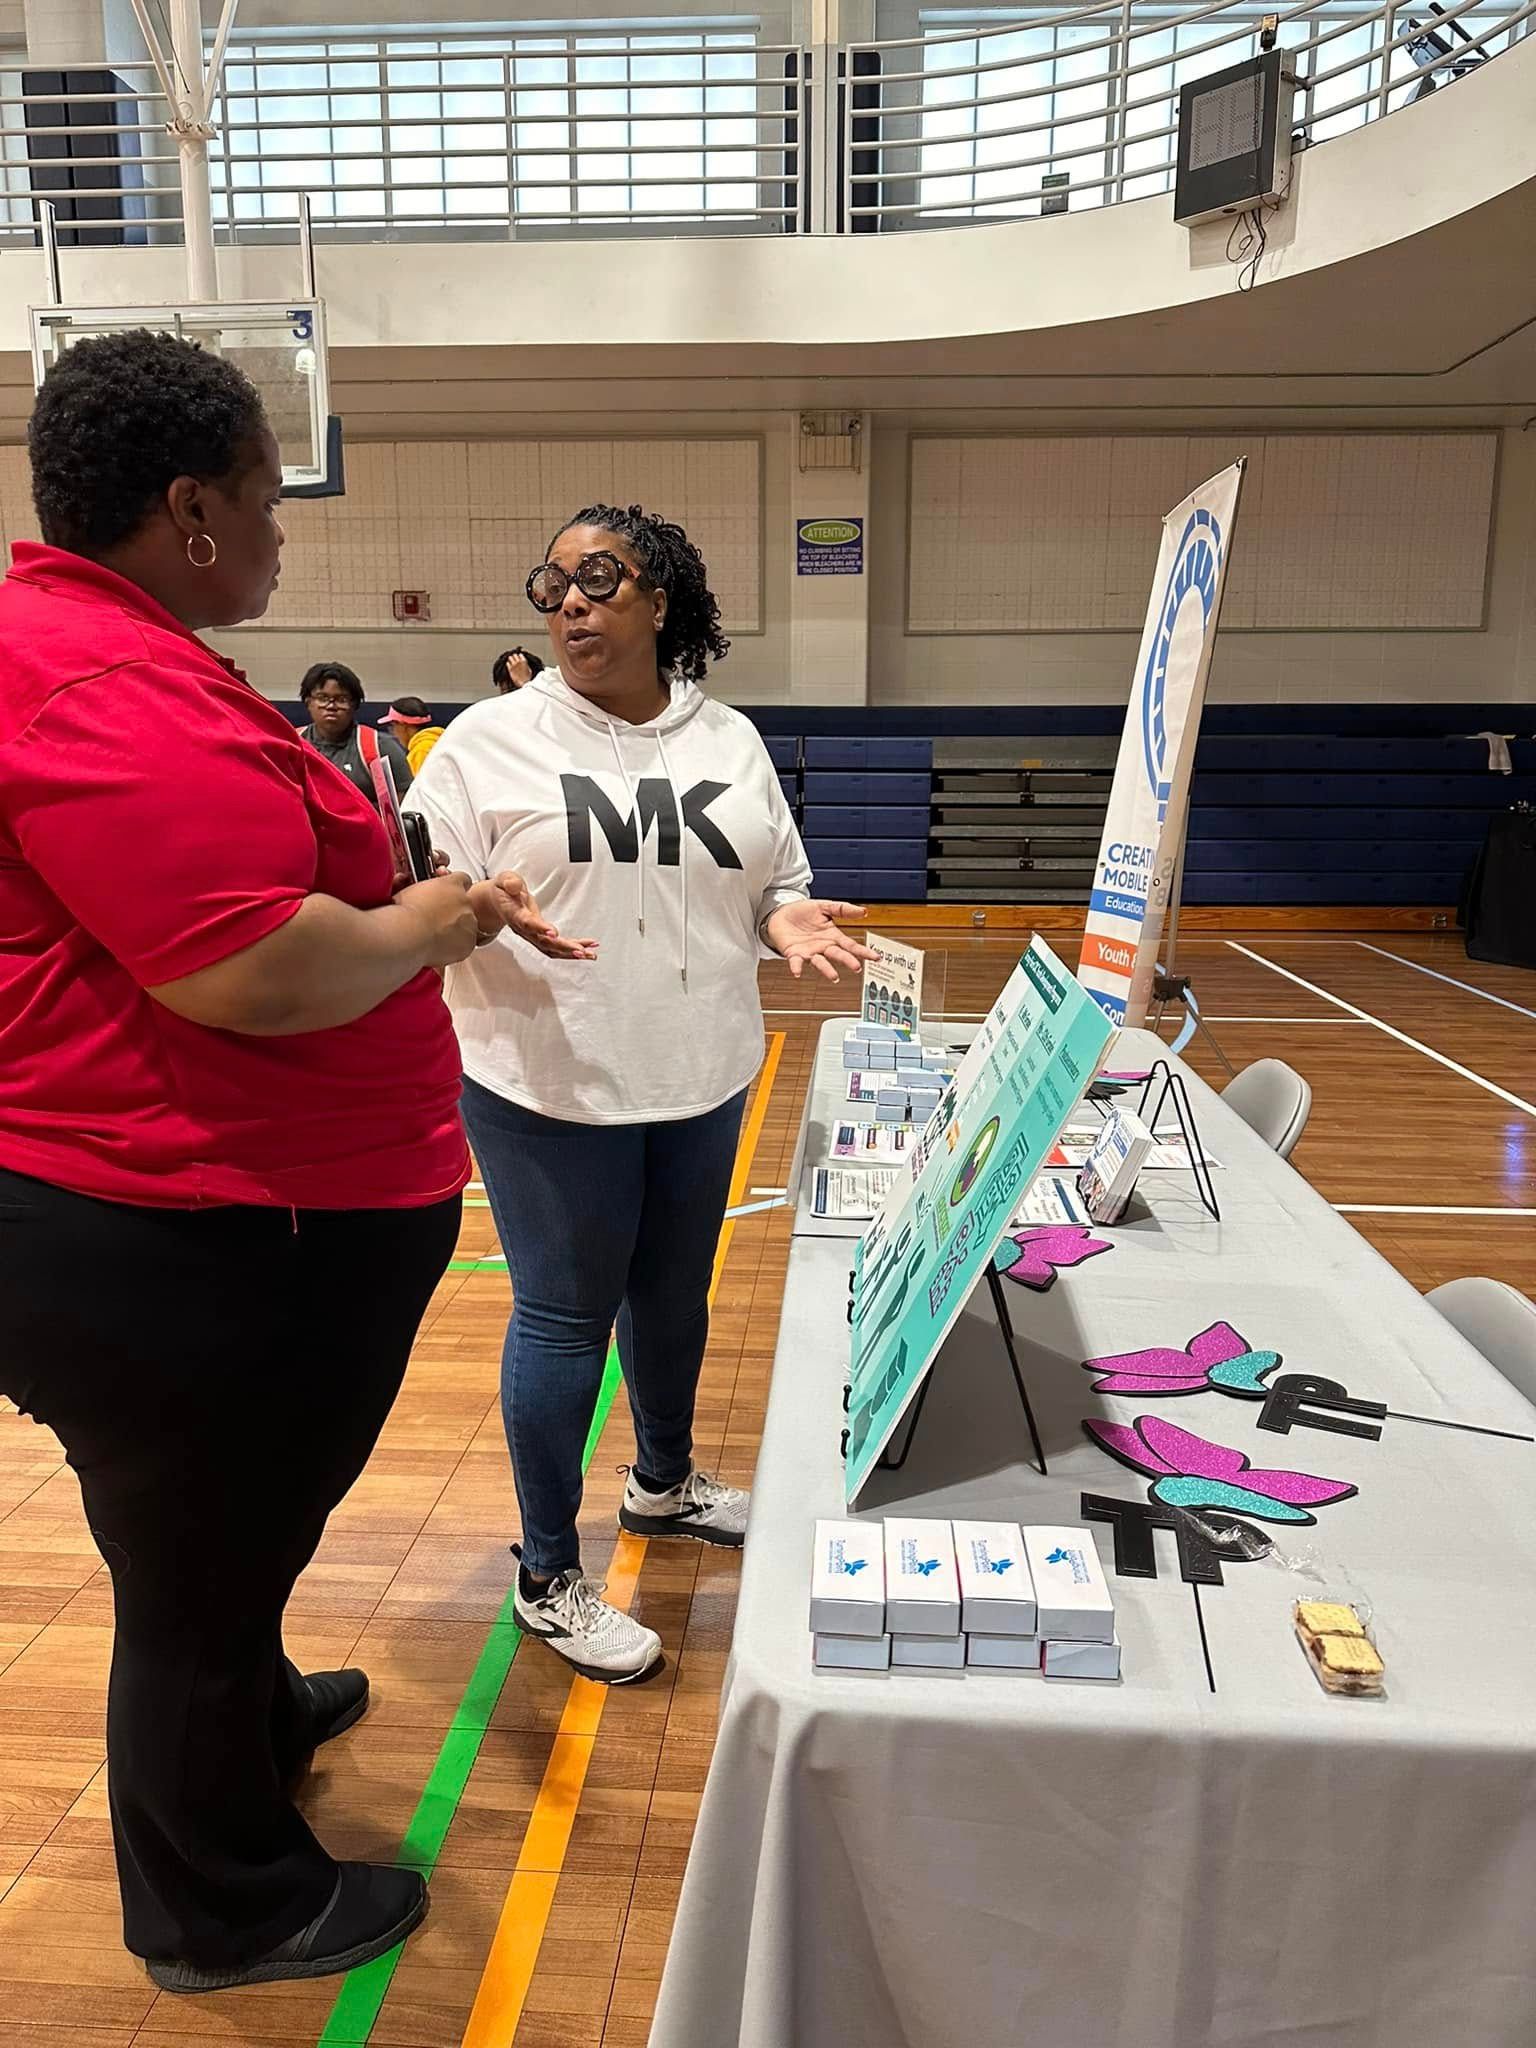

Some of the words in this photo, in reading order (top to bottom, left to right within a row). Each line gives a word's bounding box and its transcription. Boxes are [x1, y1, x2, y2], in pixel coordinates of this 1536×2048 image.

[290, 310, 313, 340] 3
[807, 526, 853, 538] ATTENTION
[560, 774, 744, 870] MK
[1103, 867, 1148, 893] MOBILE
[885, 952, 893, 965] up
[894, 954, 907, 968] with
[907, 960, 916, 971] us!
[1098, 942, 1130, 968] Youth
